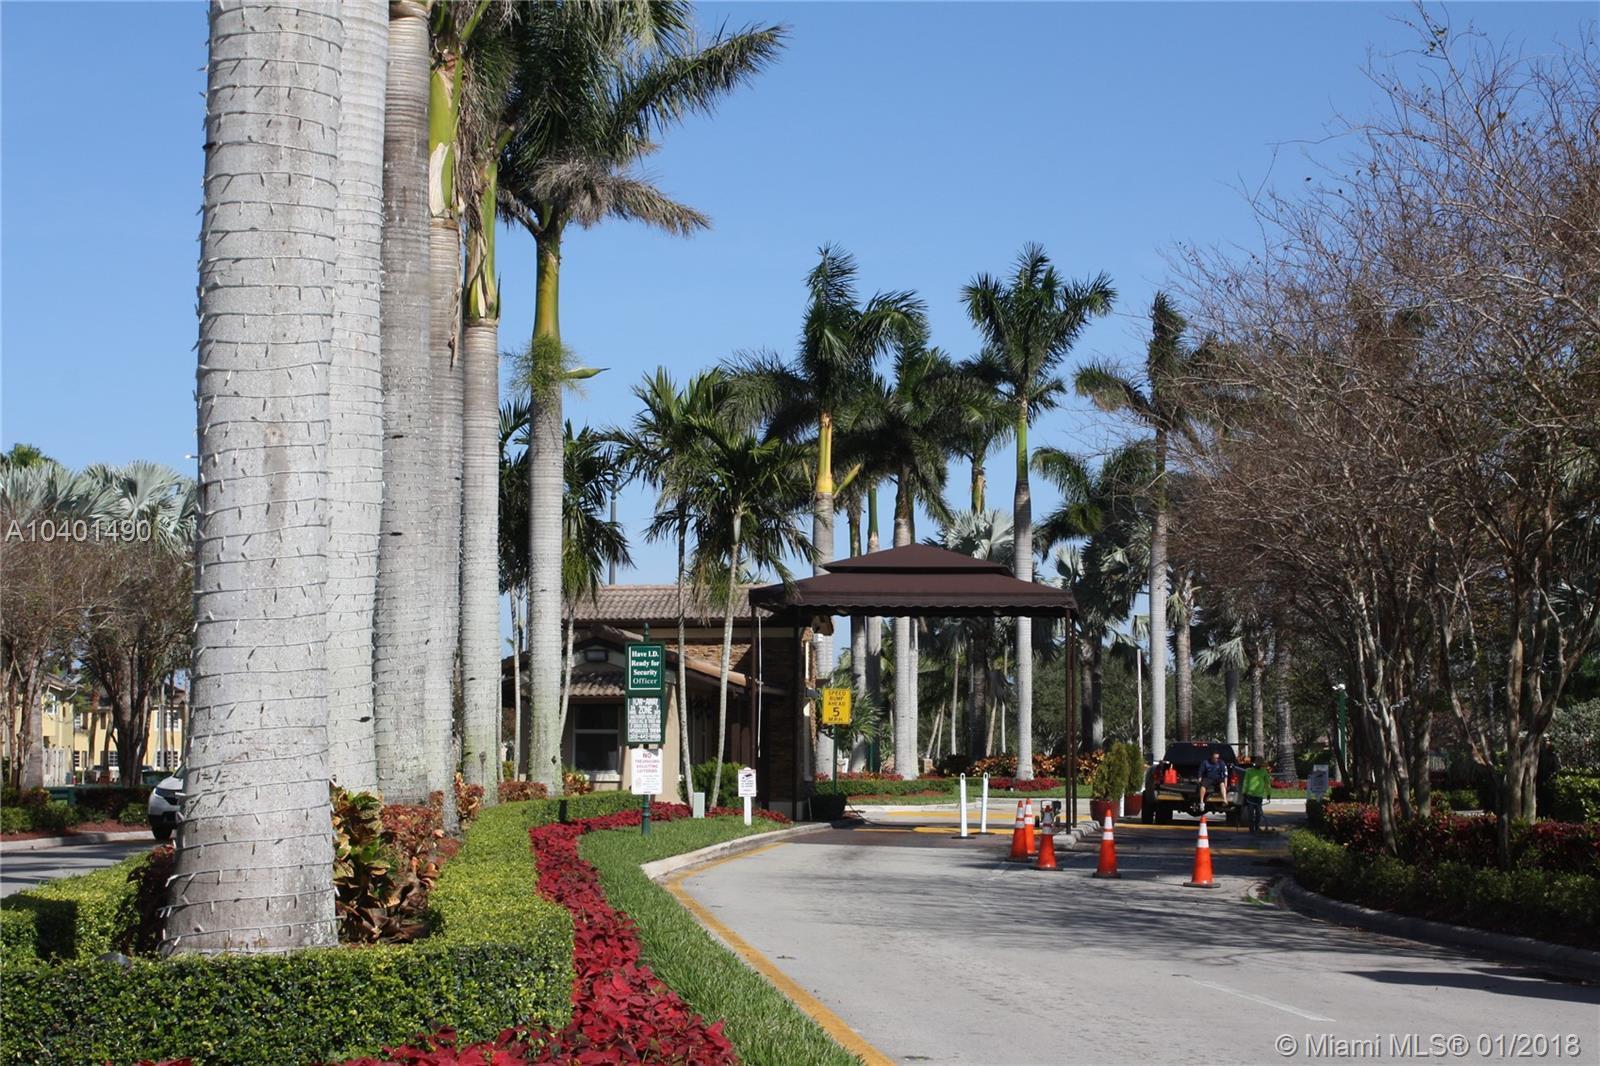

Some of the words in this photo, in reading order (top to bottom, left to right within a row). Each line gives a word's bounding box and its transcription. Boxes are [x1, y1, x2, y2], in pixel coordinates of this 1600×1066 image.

[631, 660, 649, 668] Ready
[633, 669, 657, 677] Security
[833, 706, 840, 717] 5
